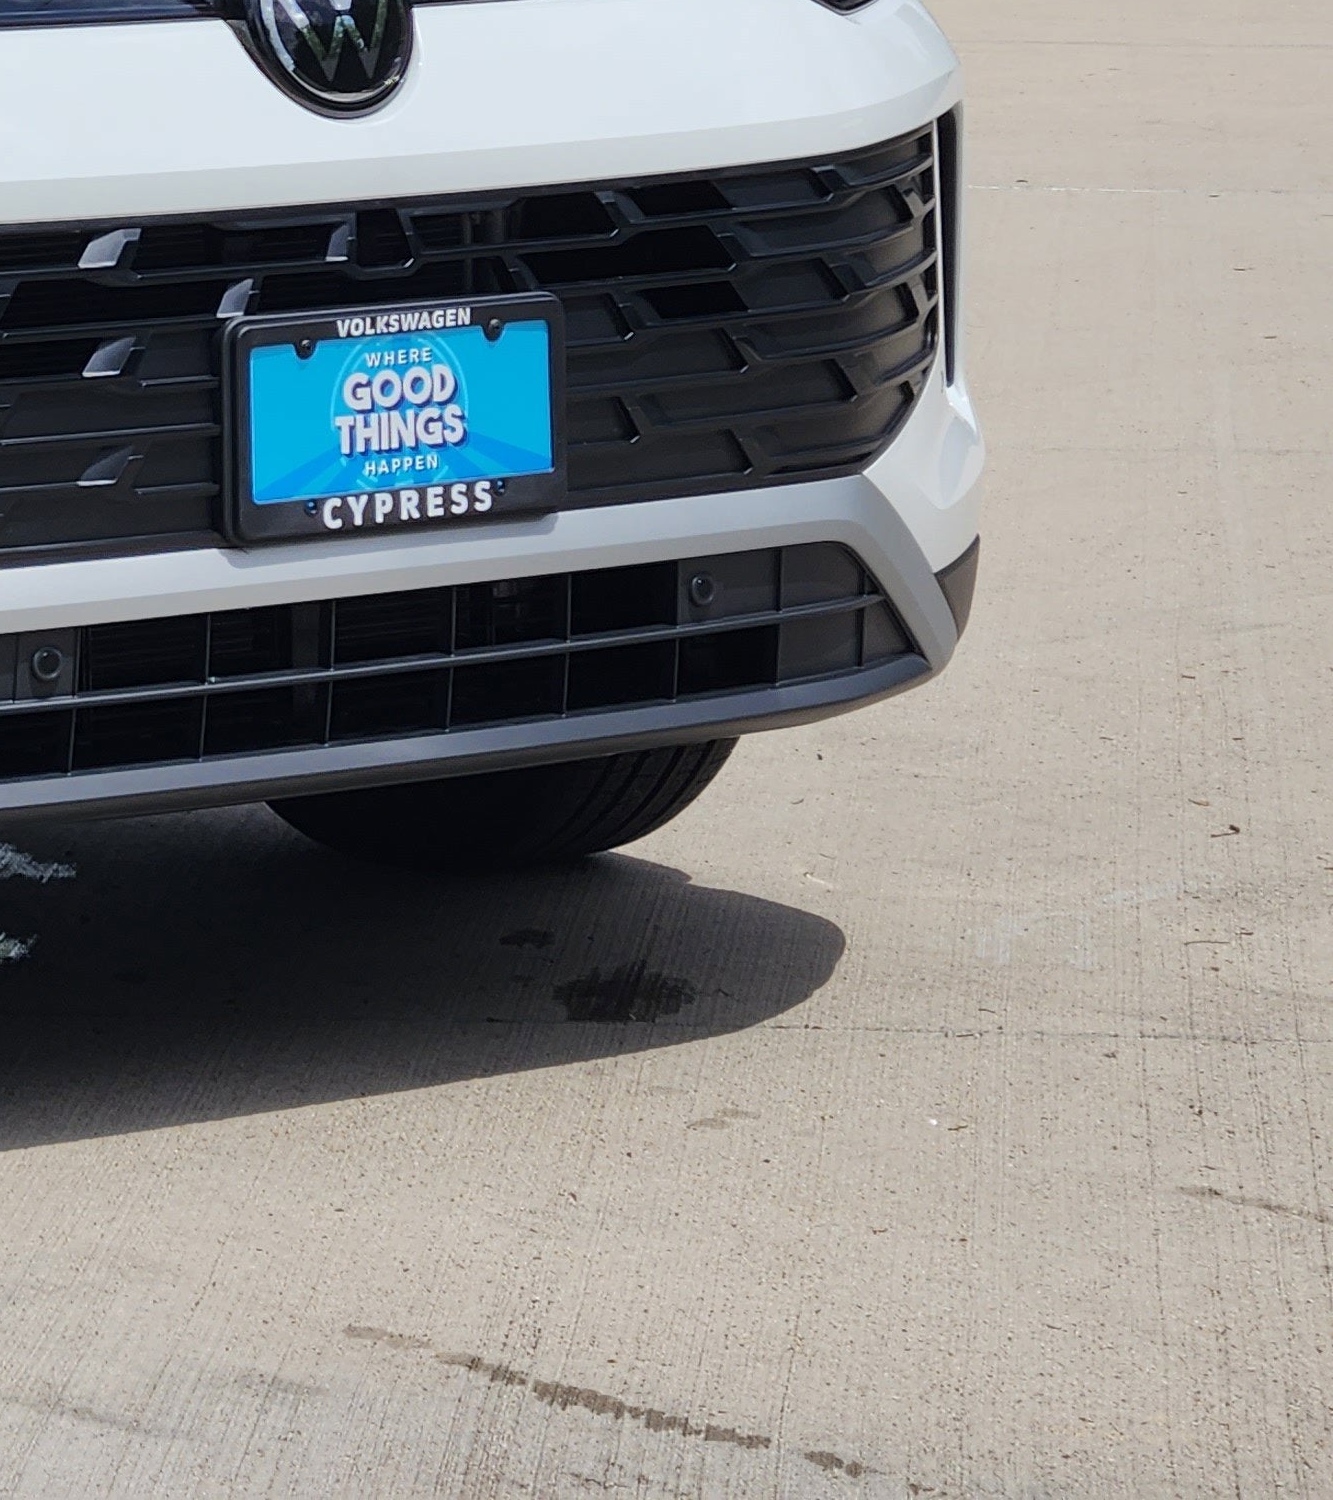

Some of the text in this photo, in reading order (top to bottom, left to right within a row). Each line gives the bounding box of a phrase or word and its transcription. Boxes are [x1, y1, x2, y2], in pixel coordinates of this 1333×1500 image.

[336, 307, 471, 338] VOLKSWAGEN
[365, 348, 433, 367] WHERE
[343, 364, 457, 411] GOOD
[335, 404, 465, 456] THINGS
[364, 455, 438, 476] HAPPEN
[323, 480, 493, 529] CYPRESS
